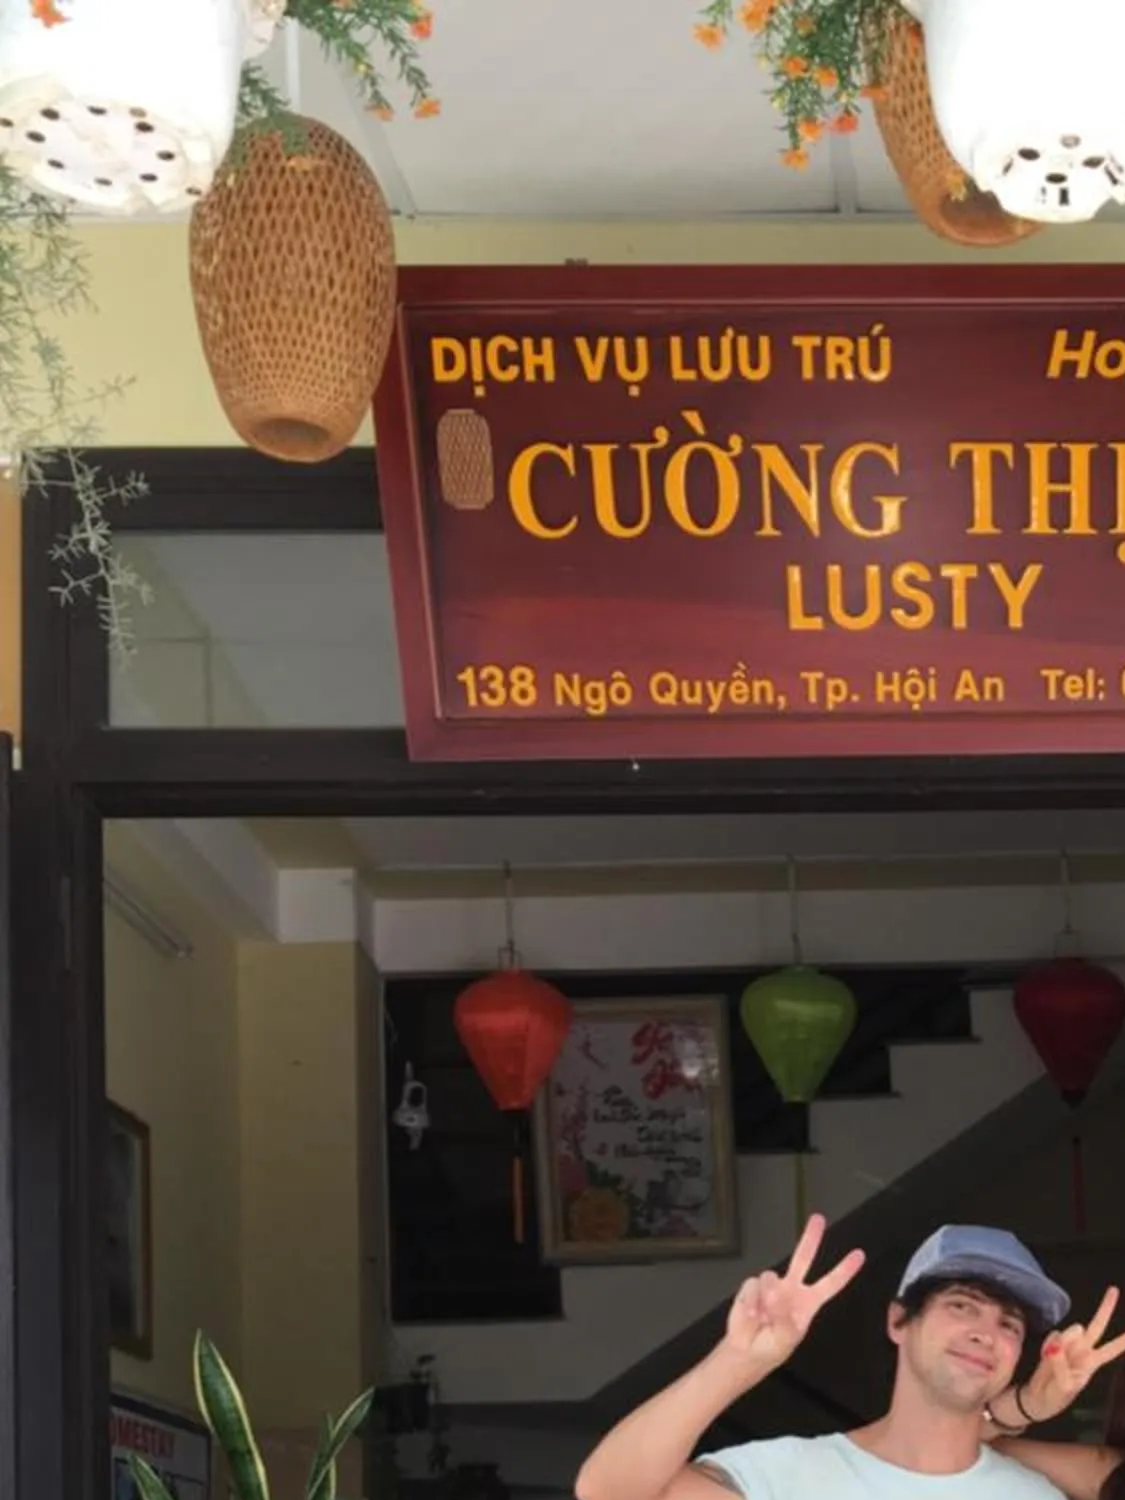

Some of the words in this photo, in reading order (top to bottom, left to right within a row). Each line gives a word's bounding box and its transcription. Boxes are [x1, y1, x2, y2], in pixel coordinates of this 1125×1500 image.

[431, 335, 555, 397] DỊCH
[575, 337, 649, 397] VỤ
[670, 327, 771, 382] LƯU
[791, 324, 892, 383] TRÚ
[507, 410, 906, 540] CƯỜNG
[786, 561, 1043, 632] LUSTY
[457, 666, 538, 708] 138
[553, 671, 633, 716] Ngô
[649, 664, 788, 714] Quyền,
[800, 670, 861, 712] Tp.
[874, 668, 938, 711] Hội
[953, 669, 1006, 703] An
[1039, 668, 1107, 702] Tel:
